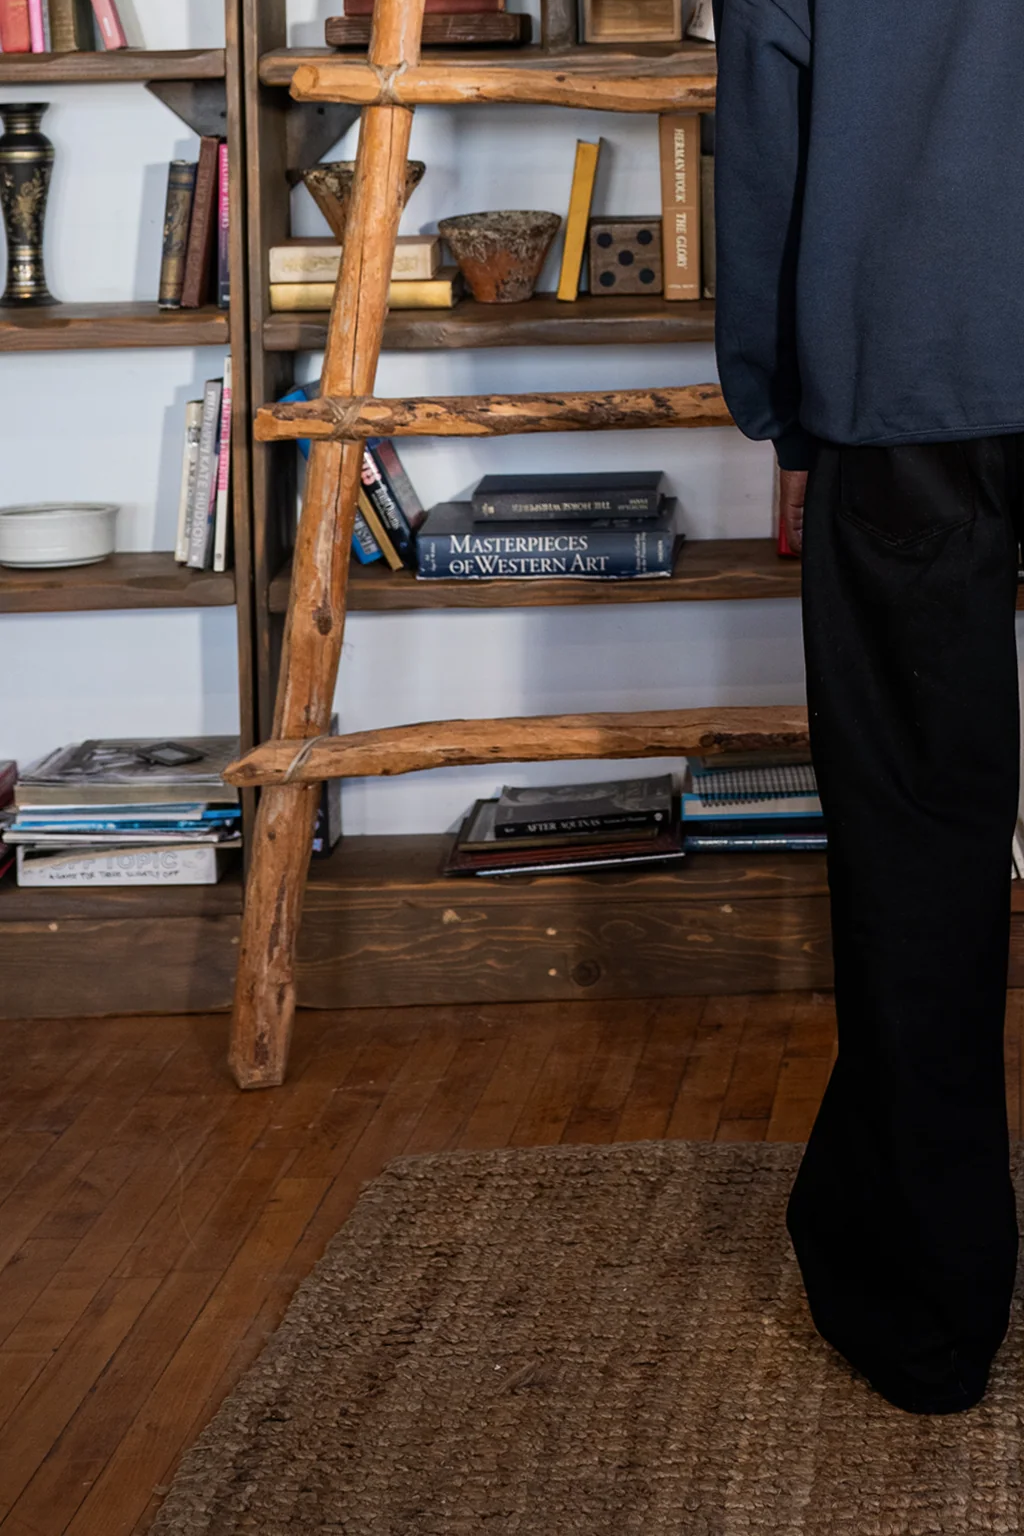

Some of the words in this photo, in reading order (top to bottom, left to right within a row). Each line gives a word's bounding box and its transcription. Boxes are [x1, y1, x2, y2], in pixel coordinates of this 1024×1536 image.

[674, 128, 685, 170] HERMAN
[675, 172, 685, 203] WOUK
[676, 212, 686, 233] THE
[676, 235, 687, 268] GLORY
[197, 454, 210, 488] KATE
[512, 502, 561, 513] WHISPERER
[562, 502, 592, 511] HORSE
[594, 502, 611, 510] THE
[192, 490, 207, 548] HUDSON
[450, 534, 588, 554] MASTERPIECES
[450, 559, 474, 575] OF
[474, 555, 564, 574] WESTERN
[571, 554, 609, 572] ART
[527, 821, 556, 833] AFTER
[561, 819, 601, 831] AQUINAS
[106, 851, 178, 870] TOPIC
[163, 870, 180, 878] OFF
